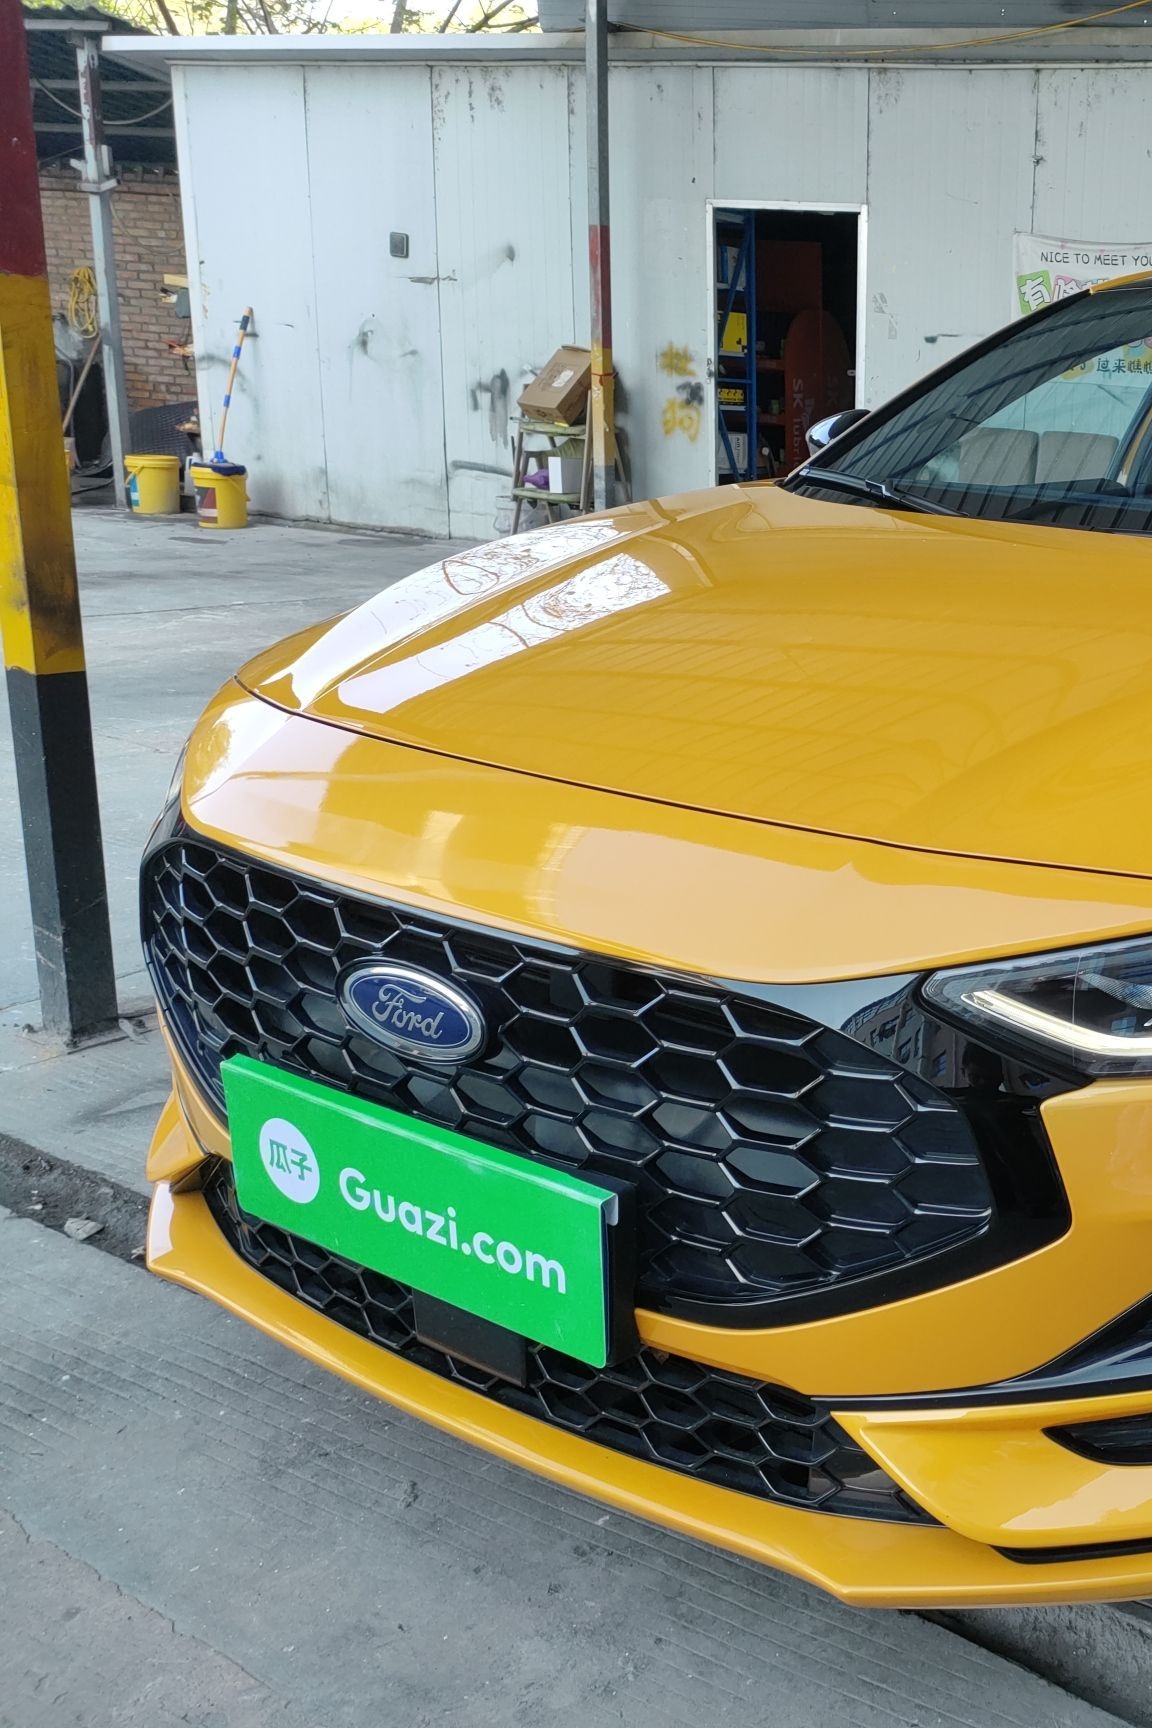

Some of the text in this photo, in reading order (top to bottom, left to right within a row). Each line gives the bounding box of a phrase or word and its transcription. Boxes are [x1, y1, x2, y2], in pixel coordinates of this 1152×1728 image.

[1040, 251, 1070, 264] NICE
[1073, 253, 1090, 265] TO
[1093, 254, 1128, 267] MEET
[373, 984, 442, 1040] Ford
[268, 1138, 312, 1181] 瓜子
[338, 1167, 567, 1294] Guazi.com
